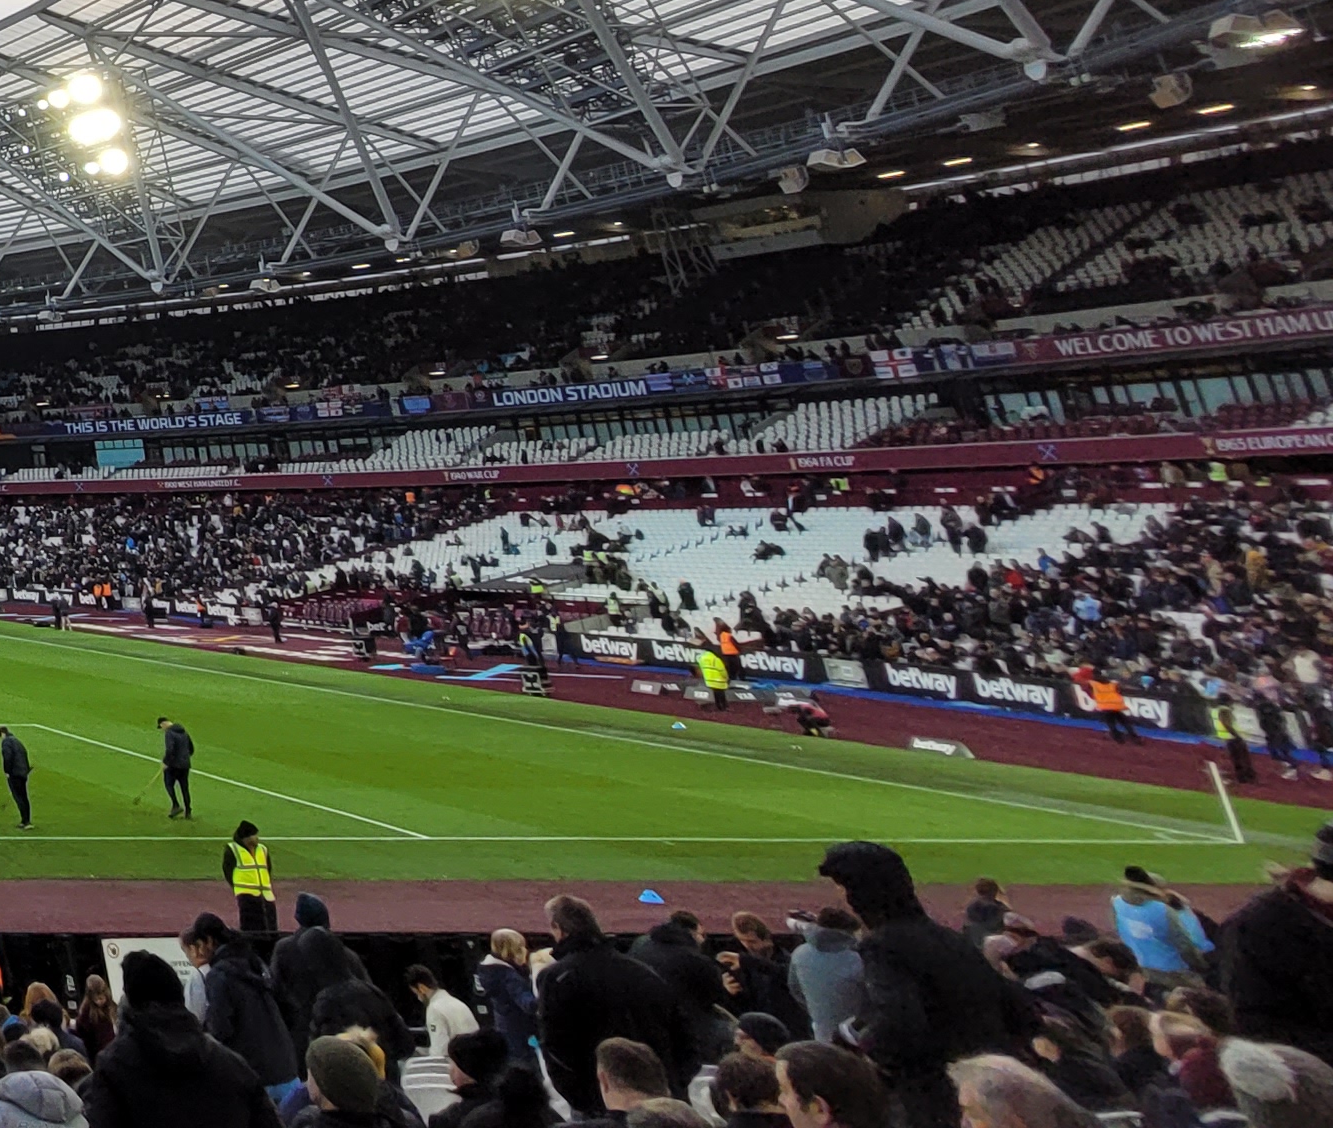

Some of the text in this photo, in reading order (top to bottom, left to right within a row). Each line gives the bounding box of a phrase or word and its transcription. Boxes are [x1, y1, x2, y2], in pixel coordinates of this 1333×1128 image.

[1054, 328, 1160, 356] WELCOME
[1162, 327, 1191, 345] TO
[1192, 321, 1253, 342] WEST
[1251, 314, 1311, 336] HAM
[492, 380, 648, 407] LONDON STADIUM
[64, 412, 242, 434] THIS IS THE WORLD'S STAGE
[1246, 434, 1327, 450] EUROPEAN
[833, 455, 856, 467] CUP
[580, 633, 638, 660] betway
[884, 662, 957, 700] betway
[972, 672, 1056, 713] betway
[1073, 683, 1169, 729] bway
